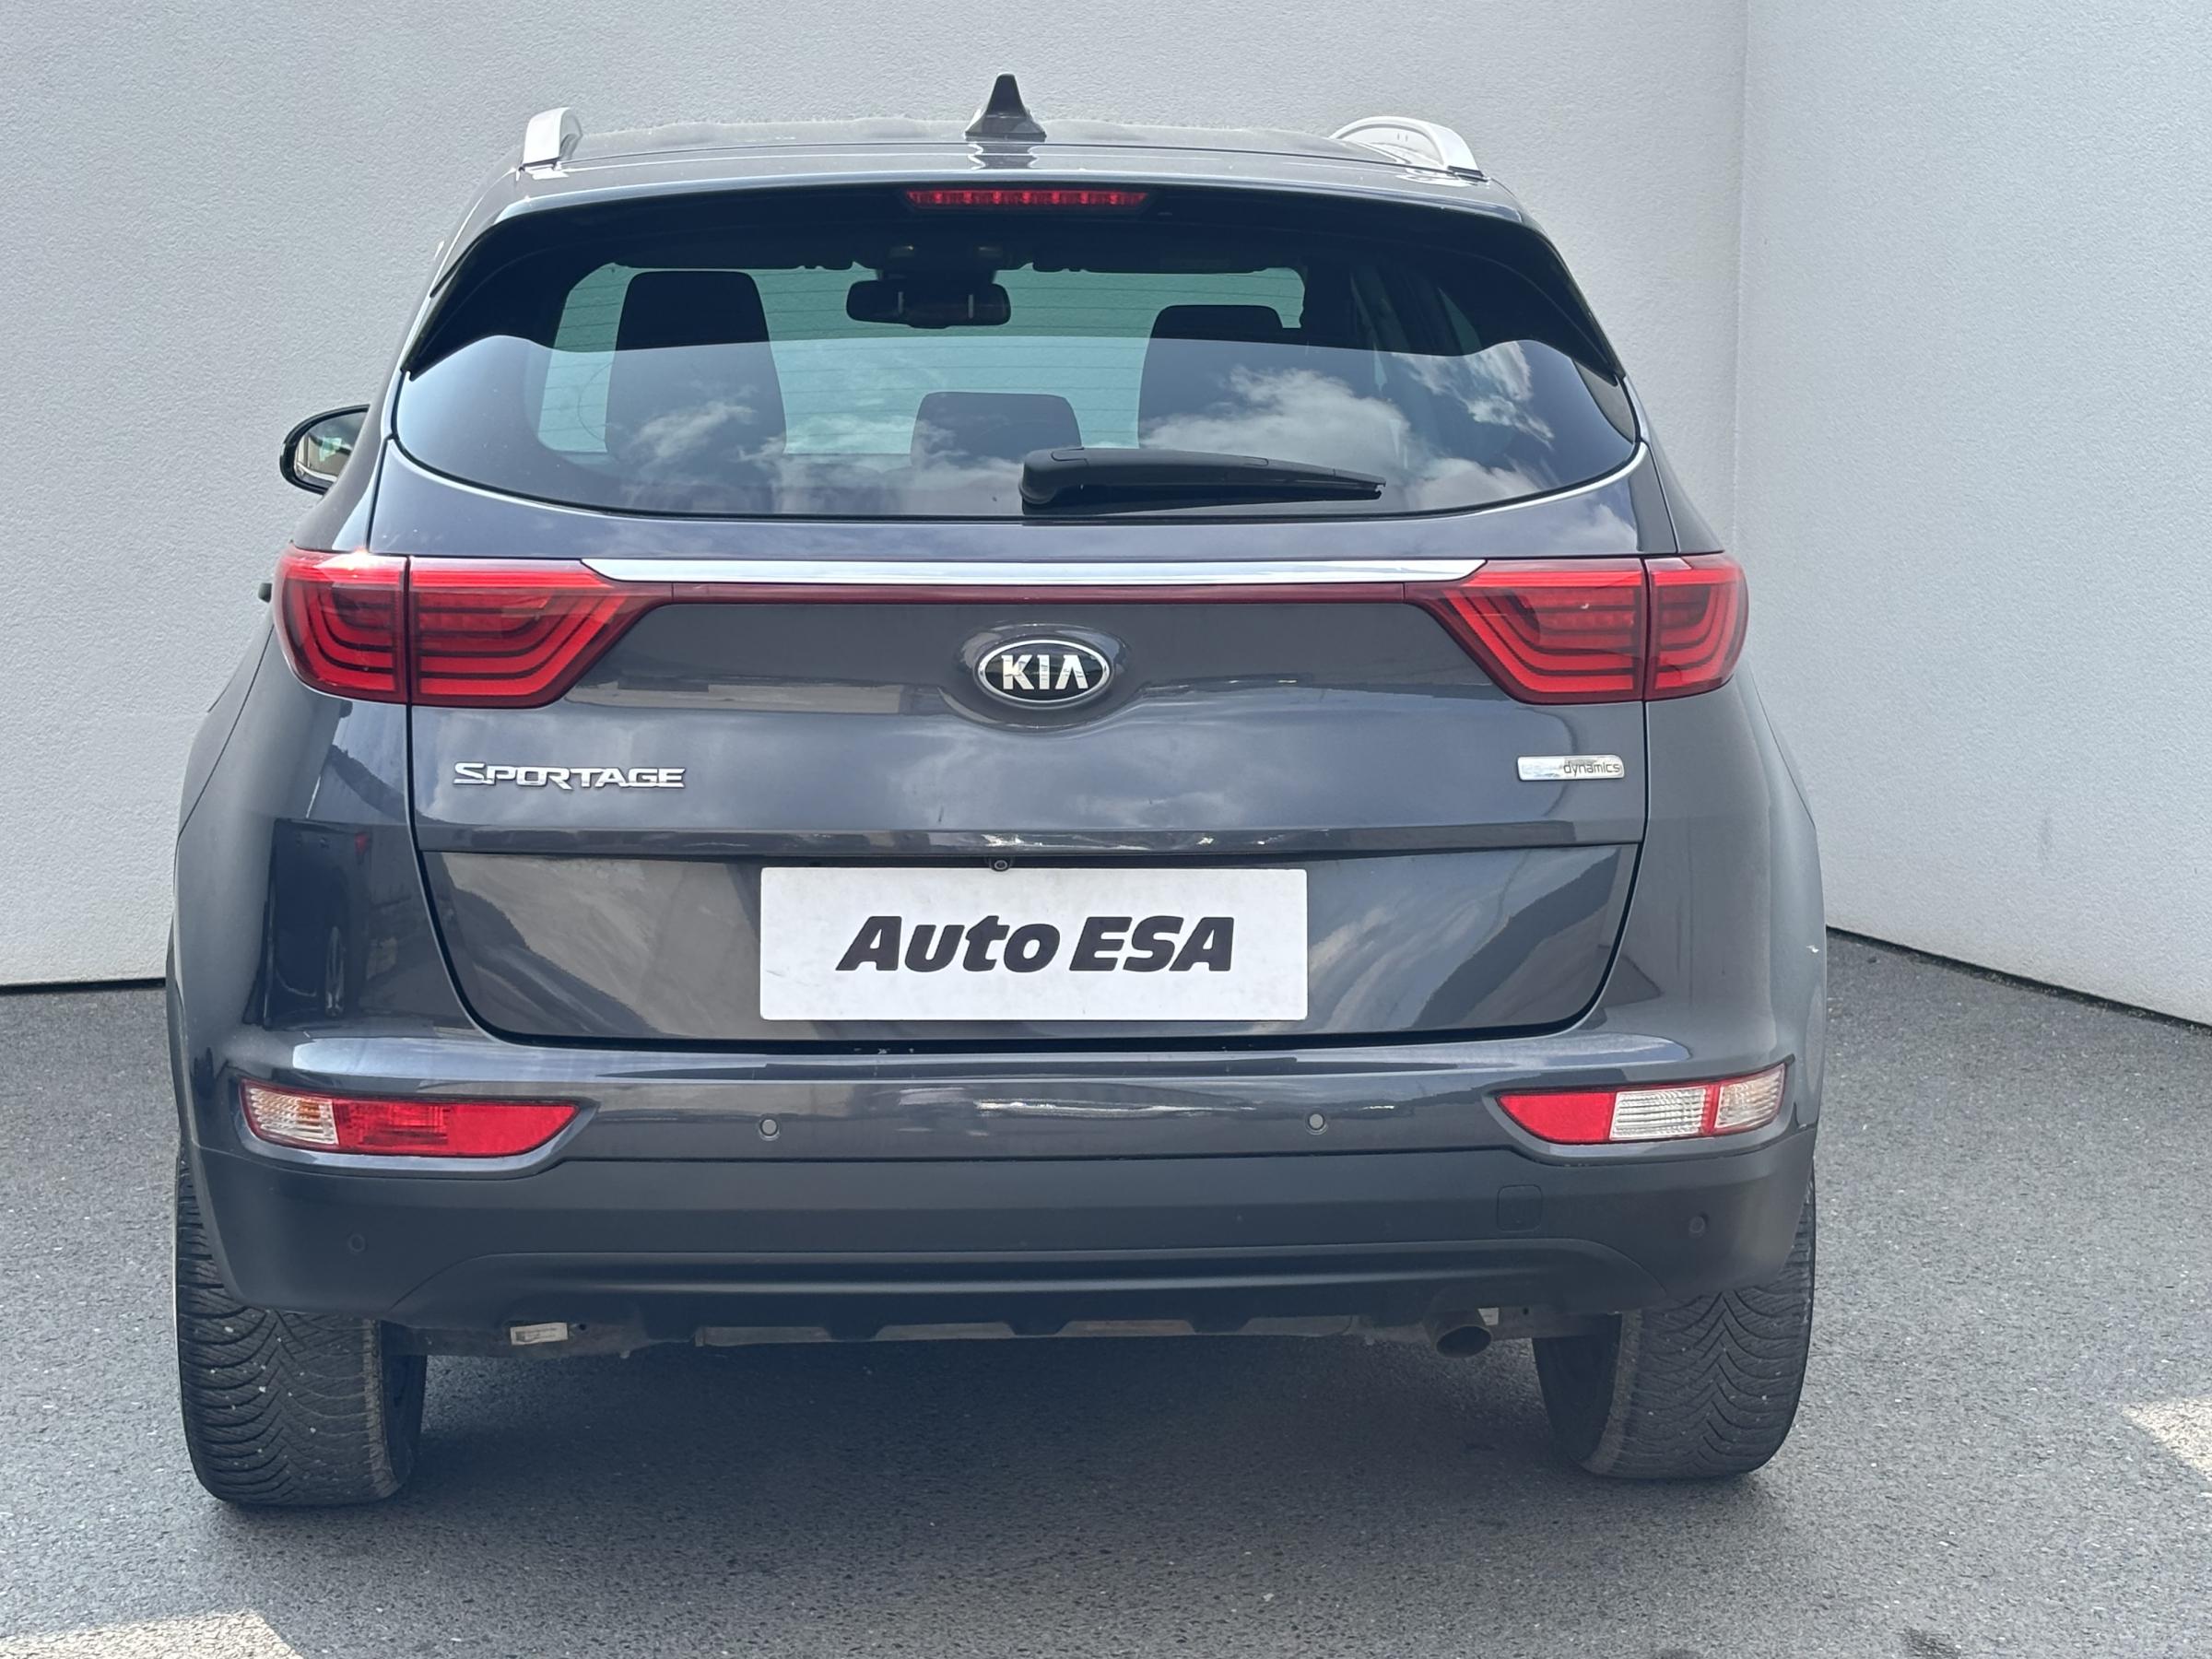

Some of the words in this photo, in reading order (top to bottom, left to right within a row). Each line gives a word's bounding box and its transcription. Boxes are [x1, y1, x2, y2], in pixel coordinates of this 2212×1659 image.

[1001, 653, 1089, 690] KIA
[453, 761, 686, 791] SPORTAGE
[1563, 760, 1621, 777] dynamics
[835, 915, 1061, 973] Auto
[1068, 915, 1235, 972] ESA
